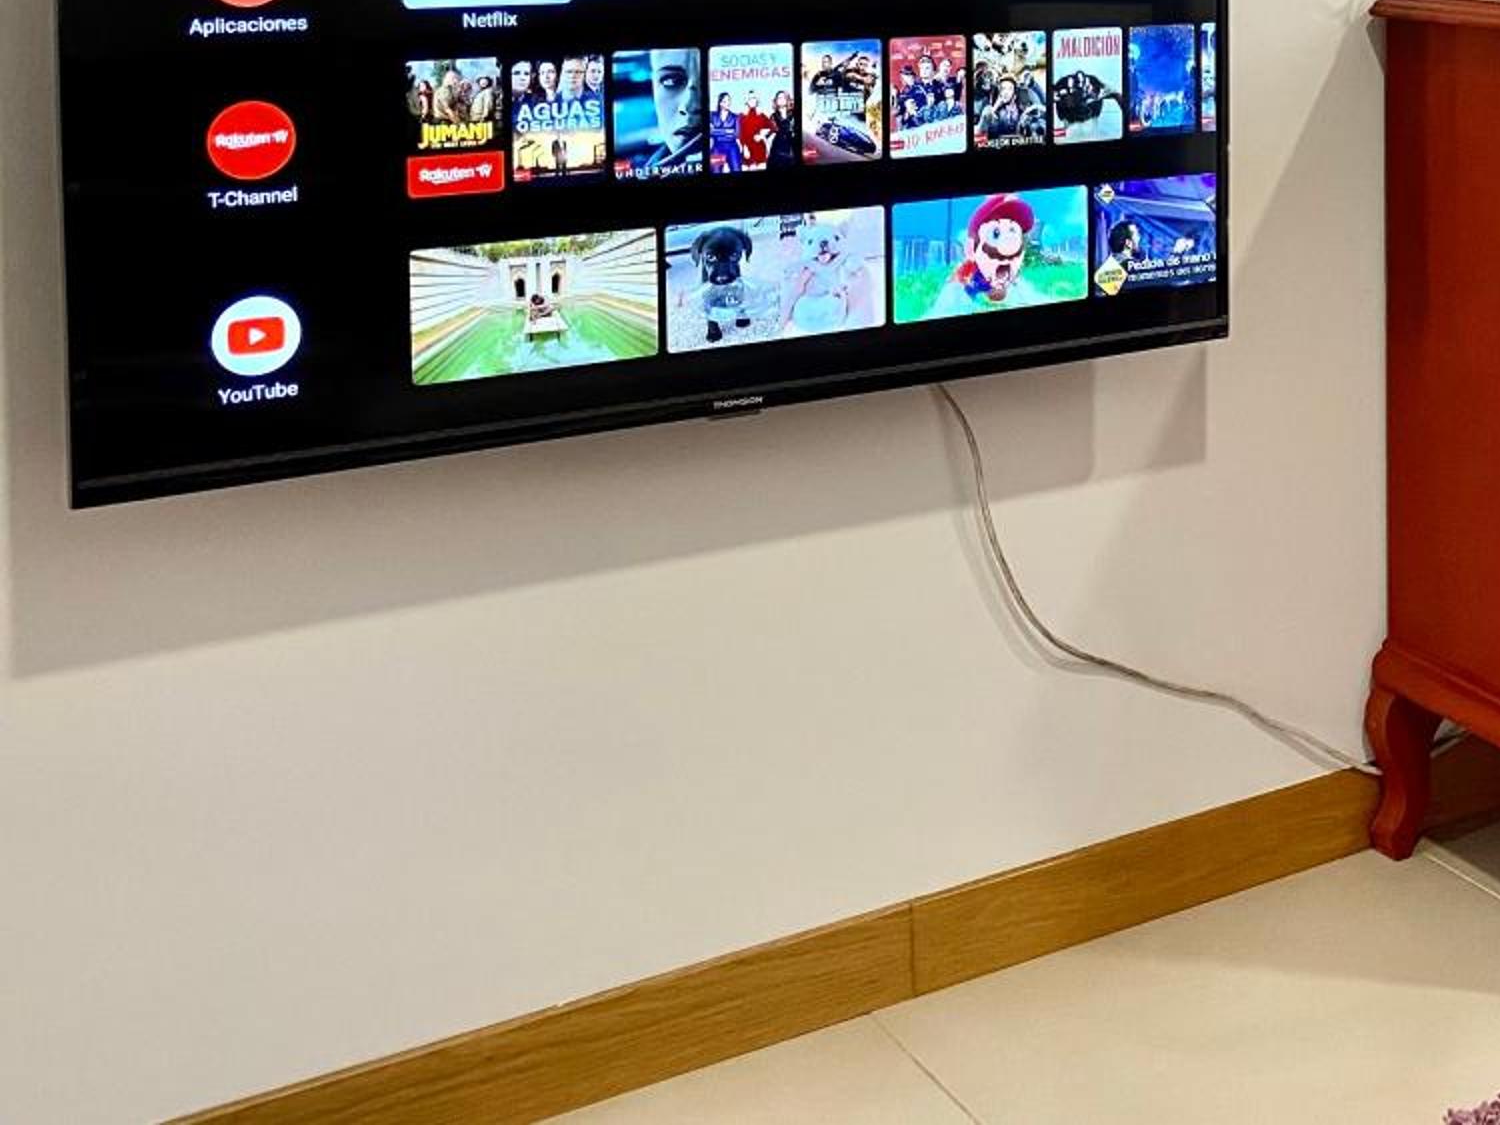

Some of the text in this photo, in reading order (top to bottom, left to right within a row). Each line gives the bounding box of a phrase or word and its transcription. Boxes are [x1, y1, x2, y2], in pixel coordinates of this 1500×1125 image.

[189, 16, 309, 38] Aplicaciones
[462, 10, 519, 29] Netflix
[711, 66, 791, 81] ENEMIGAS
[517, 100, 601, 123] AGUAS
[417, 121, 493, 149] JUMANJI
[516, 116, 601, 133] OSCURAS
[207, 184, 299, 209] T-Channel
[217, 381, 299, 405] YouTube
